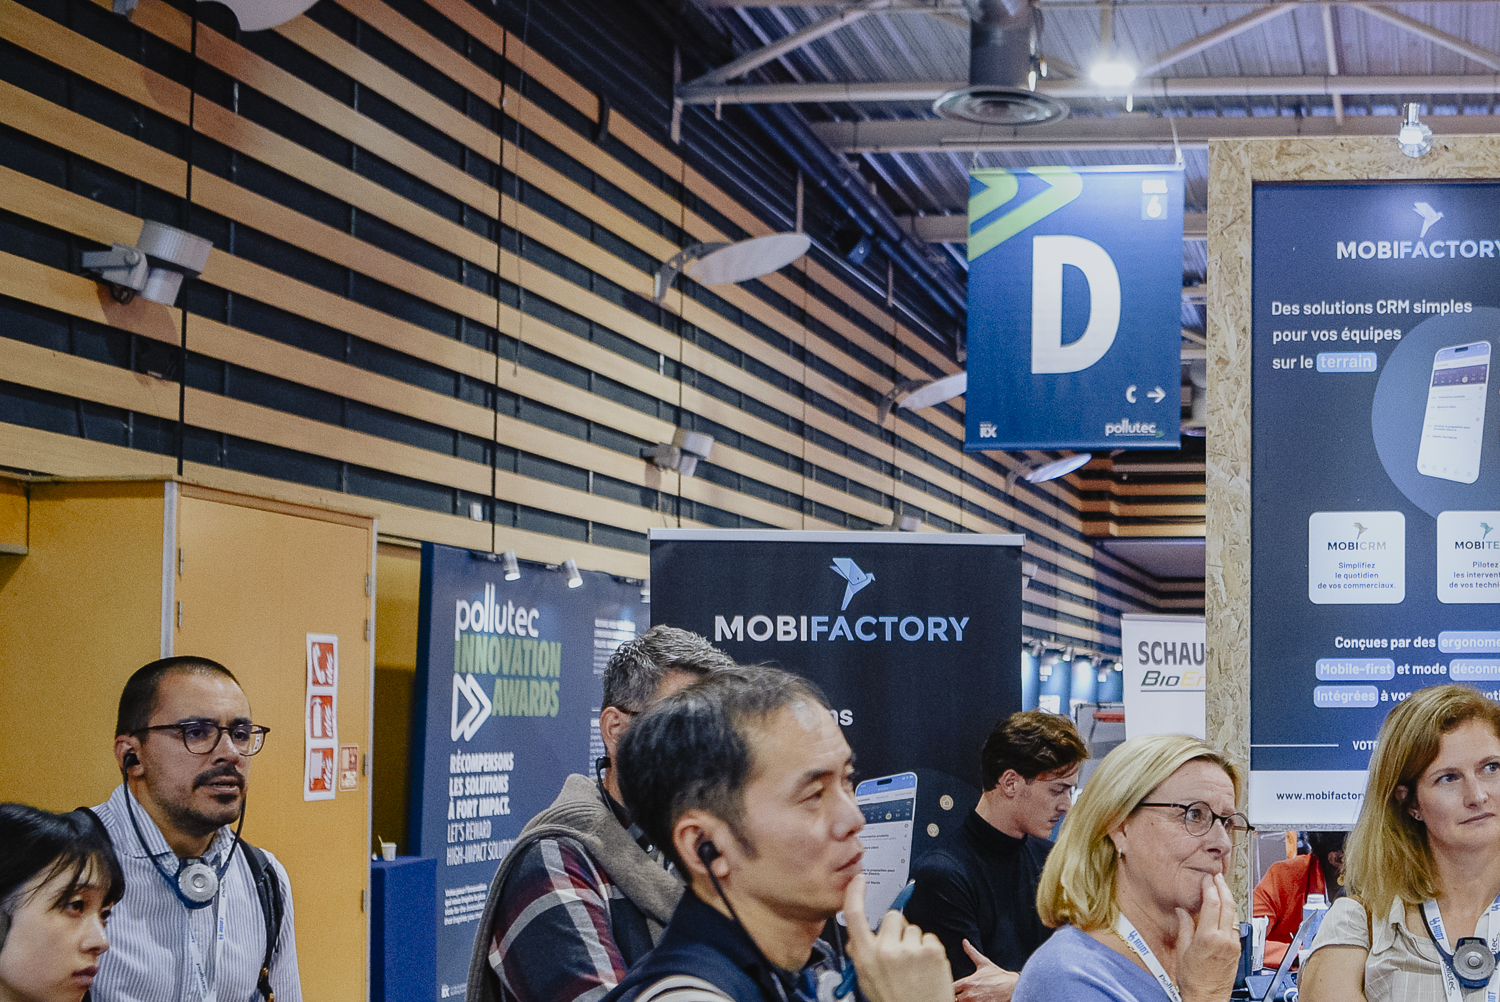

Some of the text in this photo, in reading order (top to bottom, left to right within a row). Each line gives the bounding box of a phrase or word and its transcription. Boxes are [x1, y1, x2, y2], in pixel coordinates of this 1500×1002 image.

[1147, 196, 1162, 218] 6
[1032, 234, 1121, 374] D
[1272, 300, 1472, 317] Des solutions CRM simples
[1273, 326, 1401, 344] pour vos équipes
[1273, 354, 1372, 369] sur le terrain
[1126, 385, 1136, 403] C
[1105, 419, 1156, 437] pollutec
[1328, 541, 1386, 551] MOBICRM
[1472, 561, 1499, 569] Pilotez
[1344, 572, 1379, 581] quotidien
[456, 583, 540, 641] pollutec
[715, 615, 969, 642] MOBIFACTORY
[1335, 636, 1388, 651] Conçues
[1390, 639, 1410, 651] par
[1414, 636, 1436, 648] des
[454, 634, 561, 678] INNOVATION
[1138, 641, 1204, 665] SCHAU
[1320, 663, 1392, 676] Mobile-first
[1397, 664, 1410, 675] et
[1412, 663, 1447, 675] mode
[491, 678, 559, 717] AWARDS
[1317, 689, 1375, 703] Intégrées
[1381, 689, 1388, 701] à
[450, 749, 514, 773] RÉCOMPENSONS
[449, 775, 509, 797] LES SOLUTIONS
[448, 796, 510, 820] À FORT IMPACT.
[447, 820, 491, 843] LET'S REWARD
[447, 842, 487, 866] HIGH-IMPACT
[1433, 925, 1444, 940] HUOT
[1133, 939, 1150, 956] HUOT
